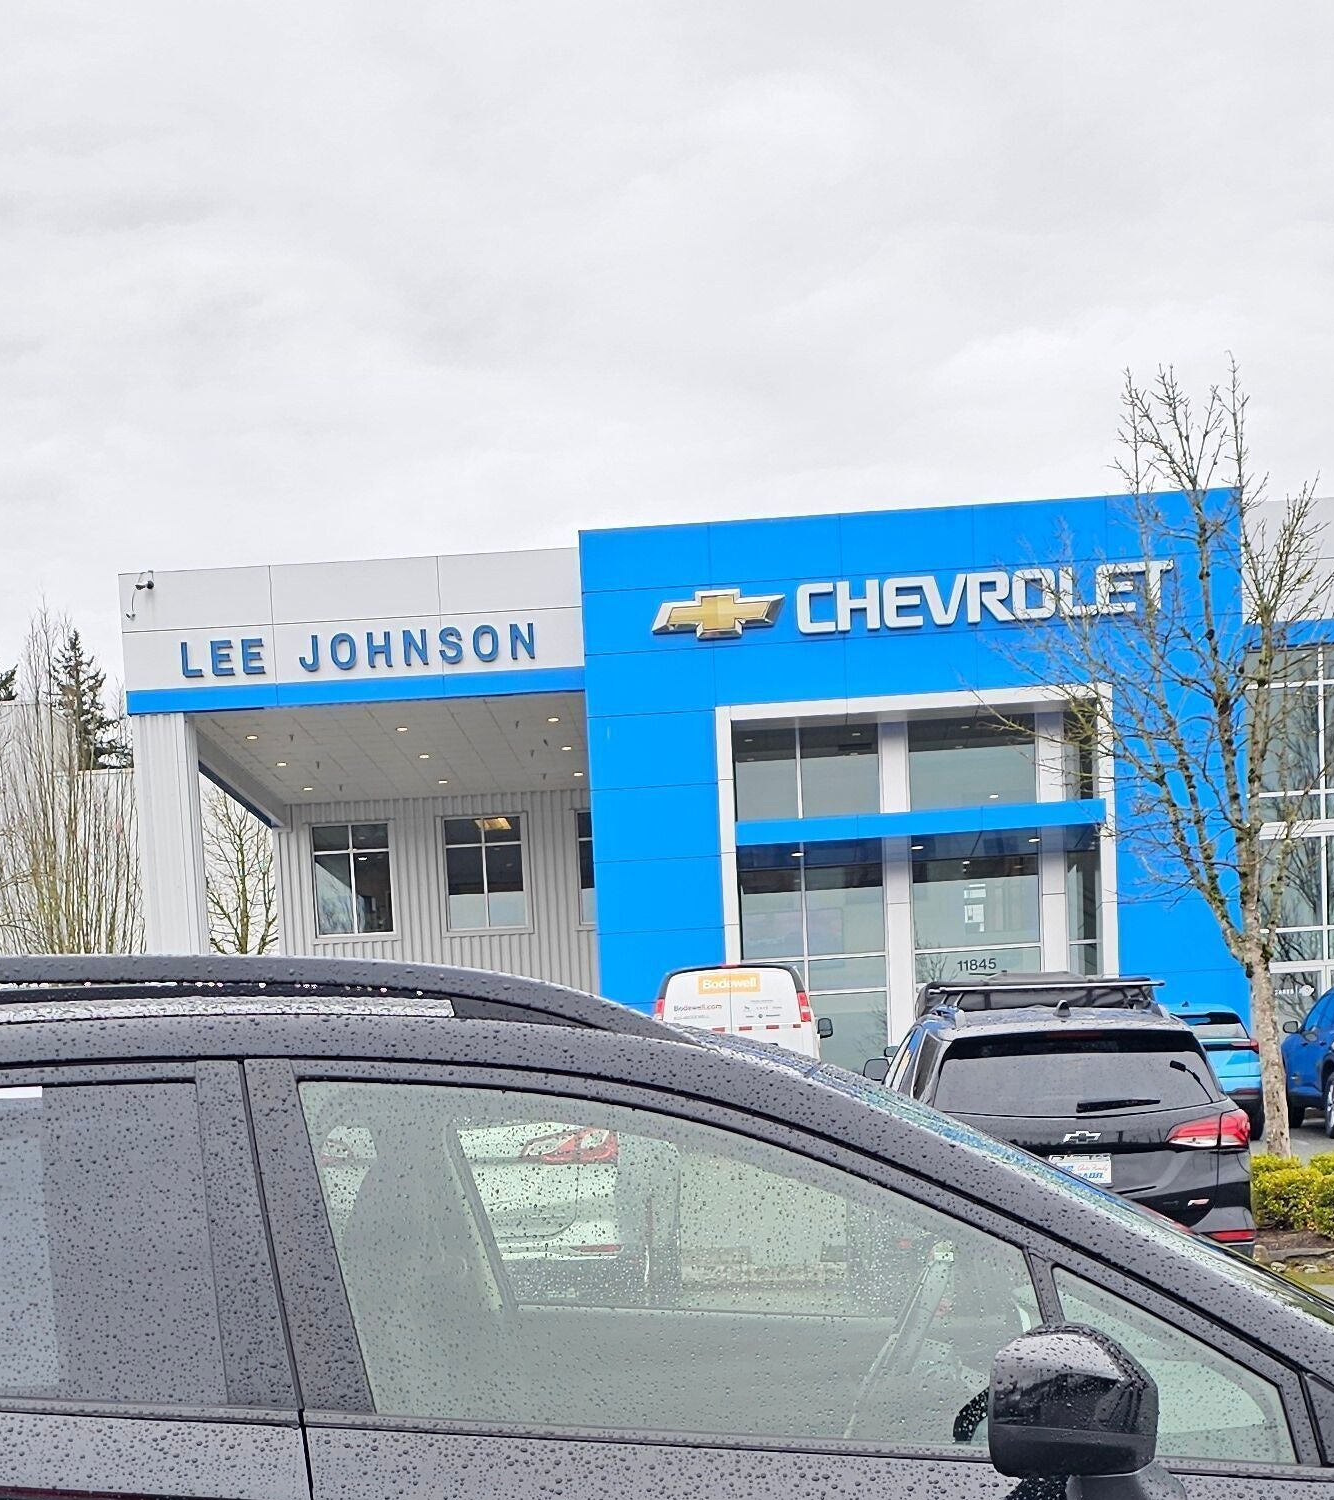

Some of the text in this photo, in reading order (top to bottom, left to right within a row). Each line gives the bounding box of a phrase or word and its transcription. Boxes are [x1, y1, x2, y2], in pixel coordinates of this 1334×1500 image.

[795, 558, 1175, 635] CHEVROLET
[180, 622, 536, 678] LEE JOHNSON
[957, 957, 997, 971] 11845
[702, 976, 757, 990] Bodewell
